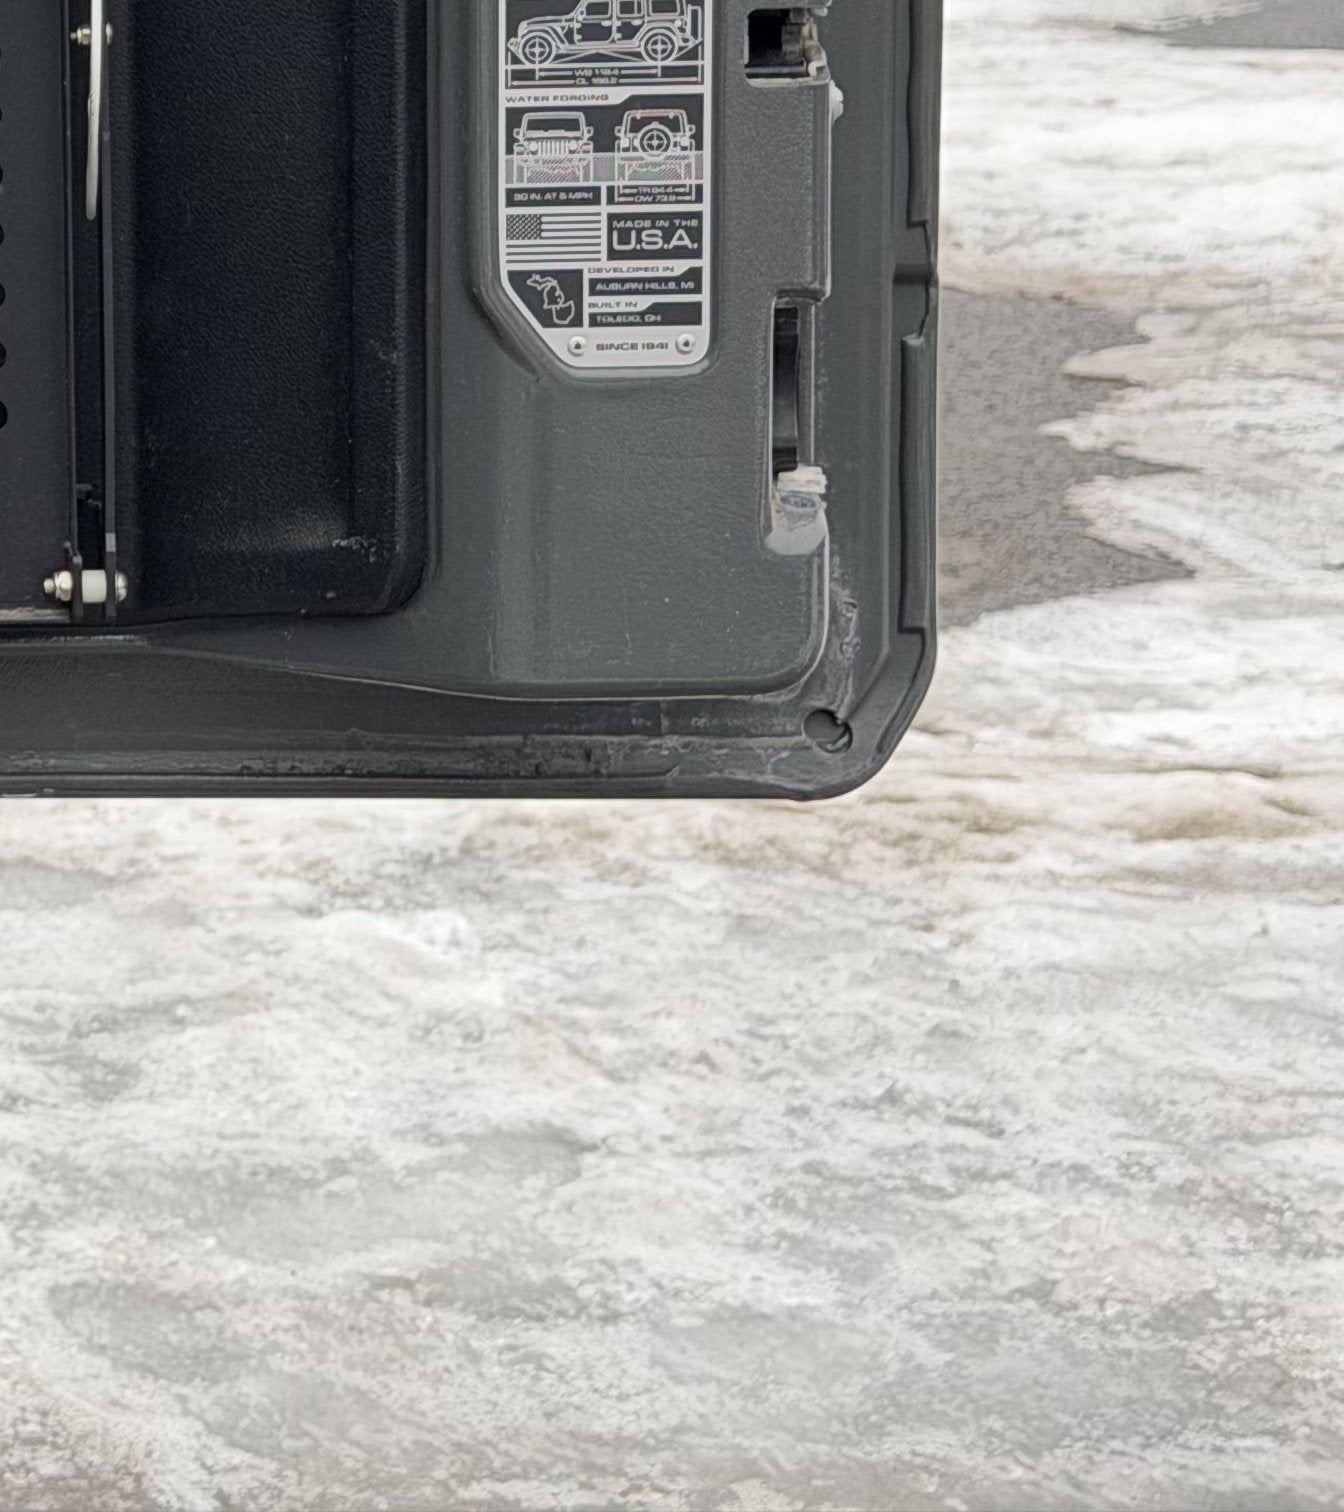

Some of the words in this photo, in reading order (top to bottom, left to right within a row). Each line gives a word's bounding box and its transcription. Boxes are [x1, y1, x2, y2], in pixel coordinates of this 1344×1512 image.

[505, 95, 550, 103] WATER
[552, 94, 610, 102] FORDING
[543, 191, 557, 200] AT
[568, 191, 593, 200] MPH
[613, 220, 652, 229] MADE
[655, 219, 669, 228] IN
[673, 219, 699, 227] THE
[612, 228, 698, 250] U.S.A.
[588, 266, 660, 274] DEVELOPED
[662, 265, 675, 273] IN
[595, 281, 644, 291] AUBURN
[680, 281, 695, 289] MI
[588, 301, 621, 309] BUILT
[596, 342, 639, 351] SINCE
[641, 342, 669, 350] 1941
